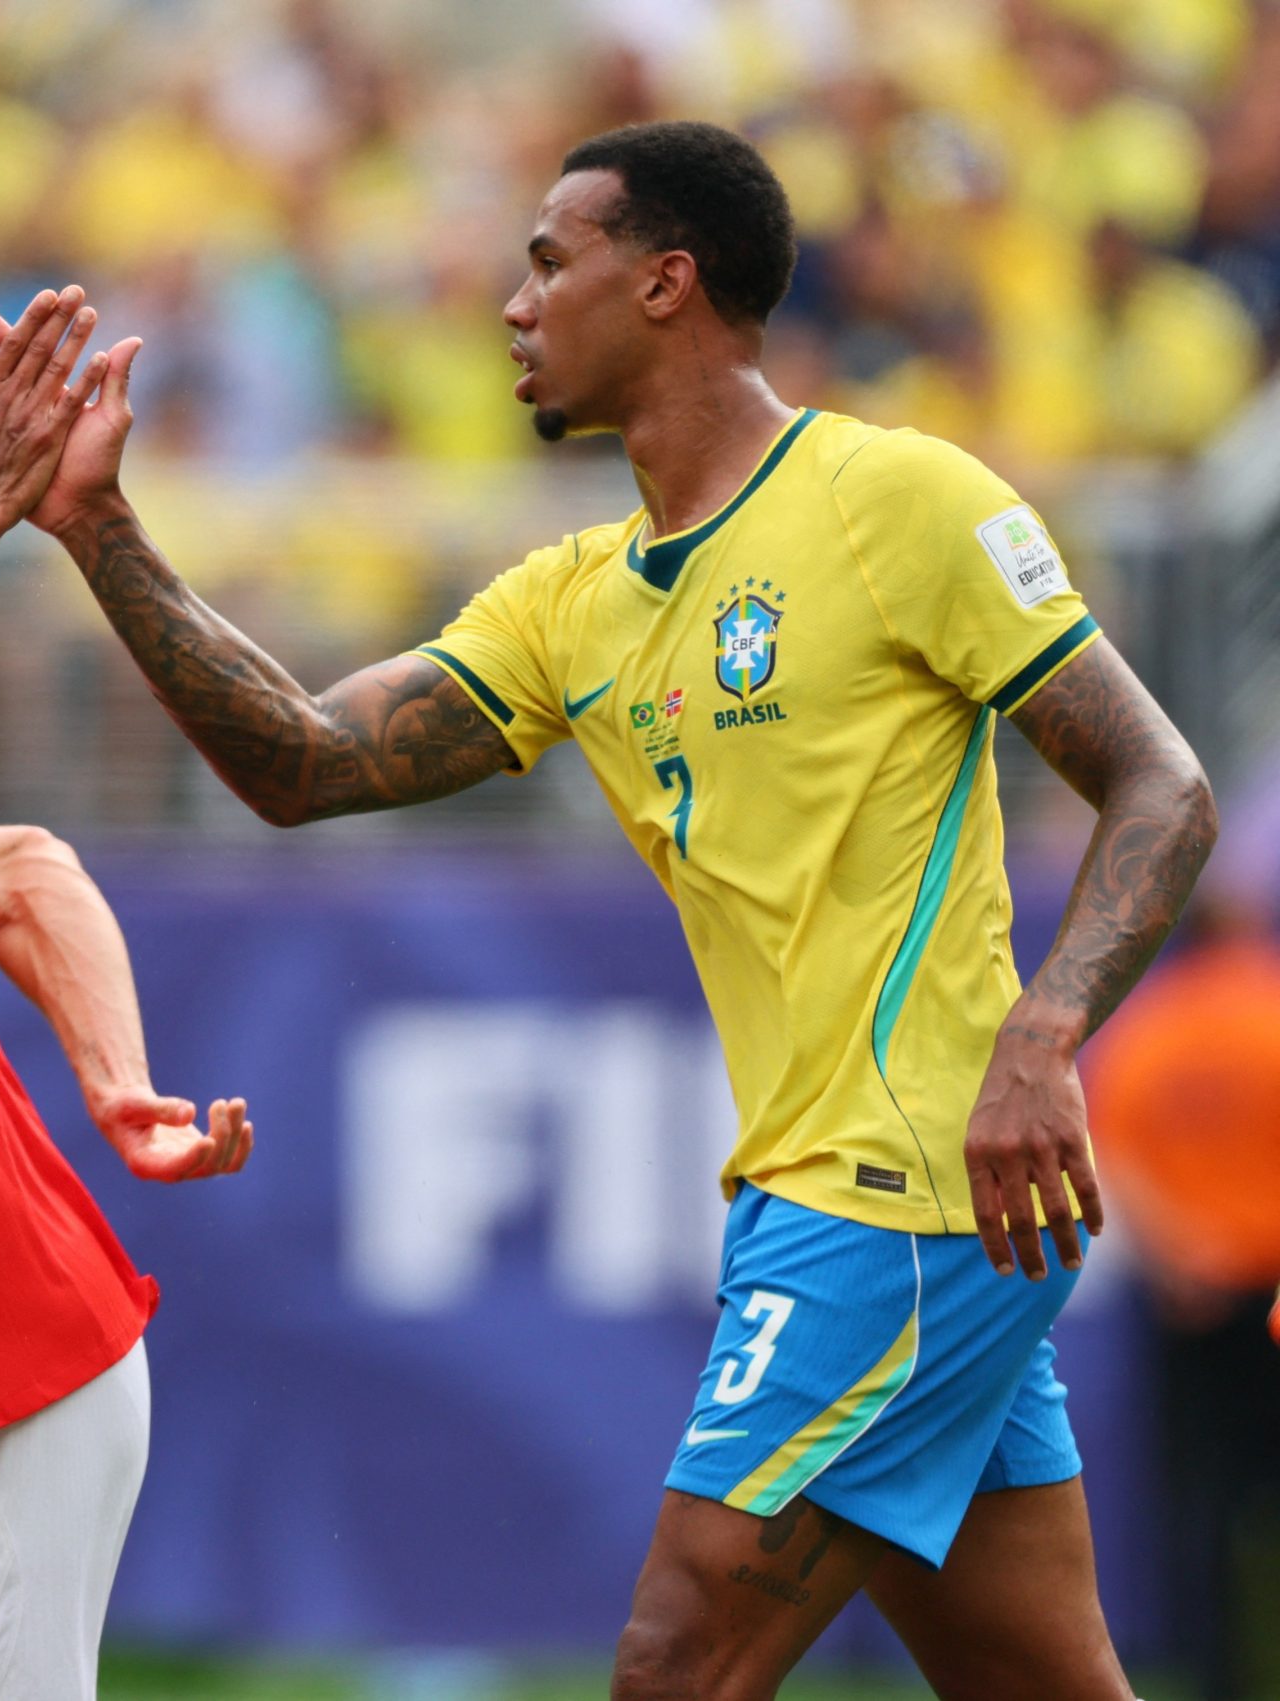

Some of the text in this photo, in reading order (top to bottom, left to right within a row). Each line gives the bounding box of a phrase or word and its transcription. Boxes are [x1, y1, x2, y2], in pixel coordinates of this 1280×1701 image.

[731, 637, 756, 651] CBF
[714, 702, 787, 731] BRASIL
[712, 1288, 796, 1405] 3
